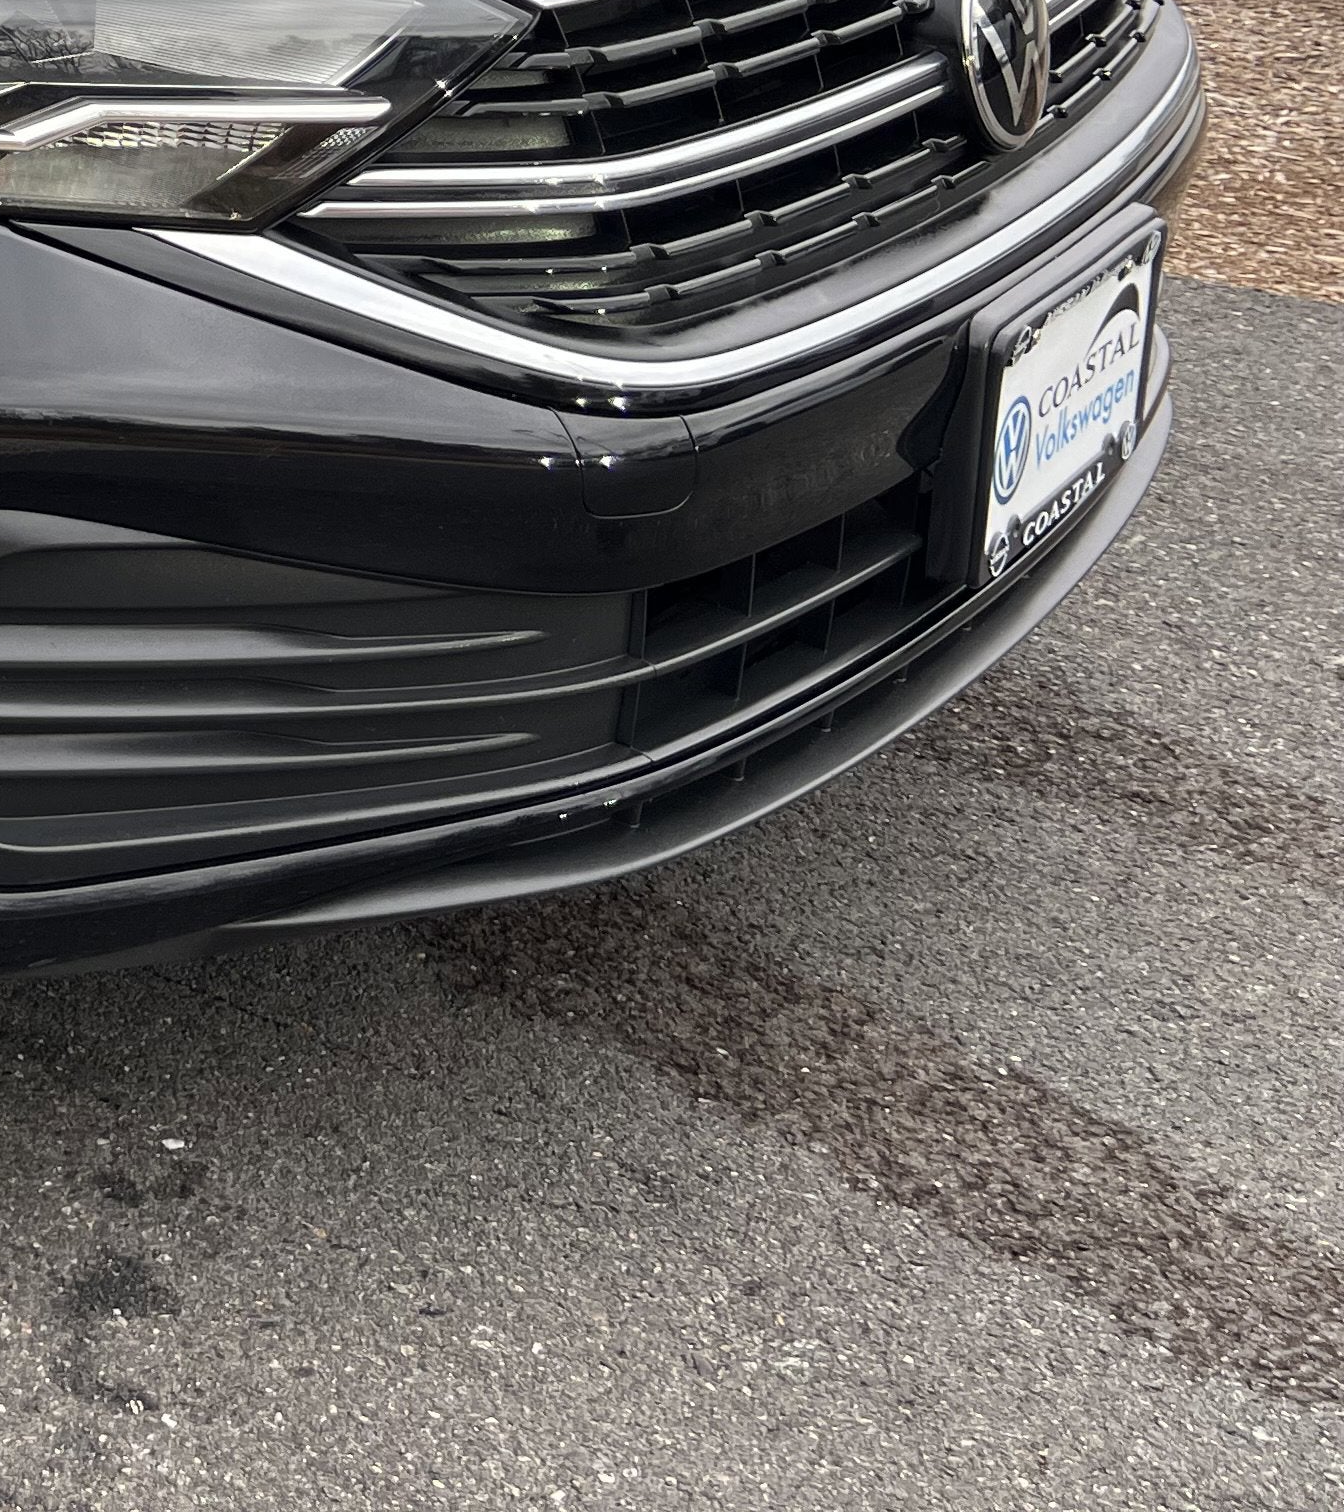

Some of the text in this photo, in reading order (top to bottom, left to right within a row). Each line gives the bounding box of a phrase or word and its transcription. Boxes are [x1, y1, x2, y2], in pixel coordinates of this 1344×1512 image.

[1038, 322, 1140, 417] COASTAL
[1035, 369, 1135, 471] Volkswagen
[1022, 461, 1106, 546] COASTAL
